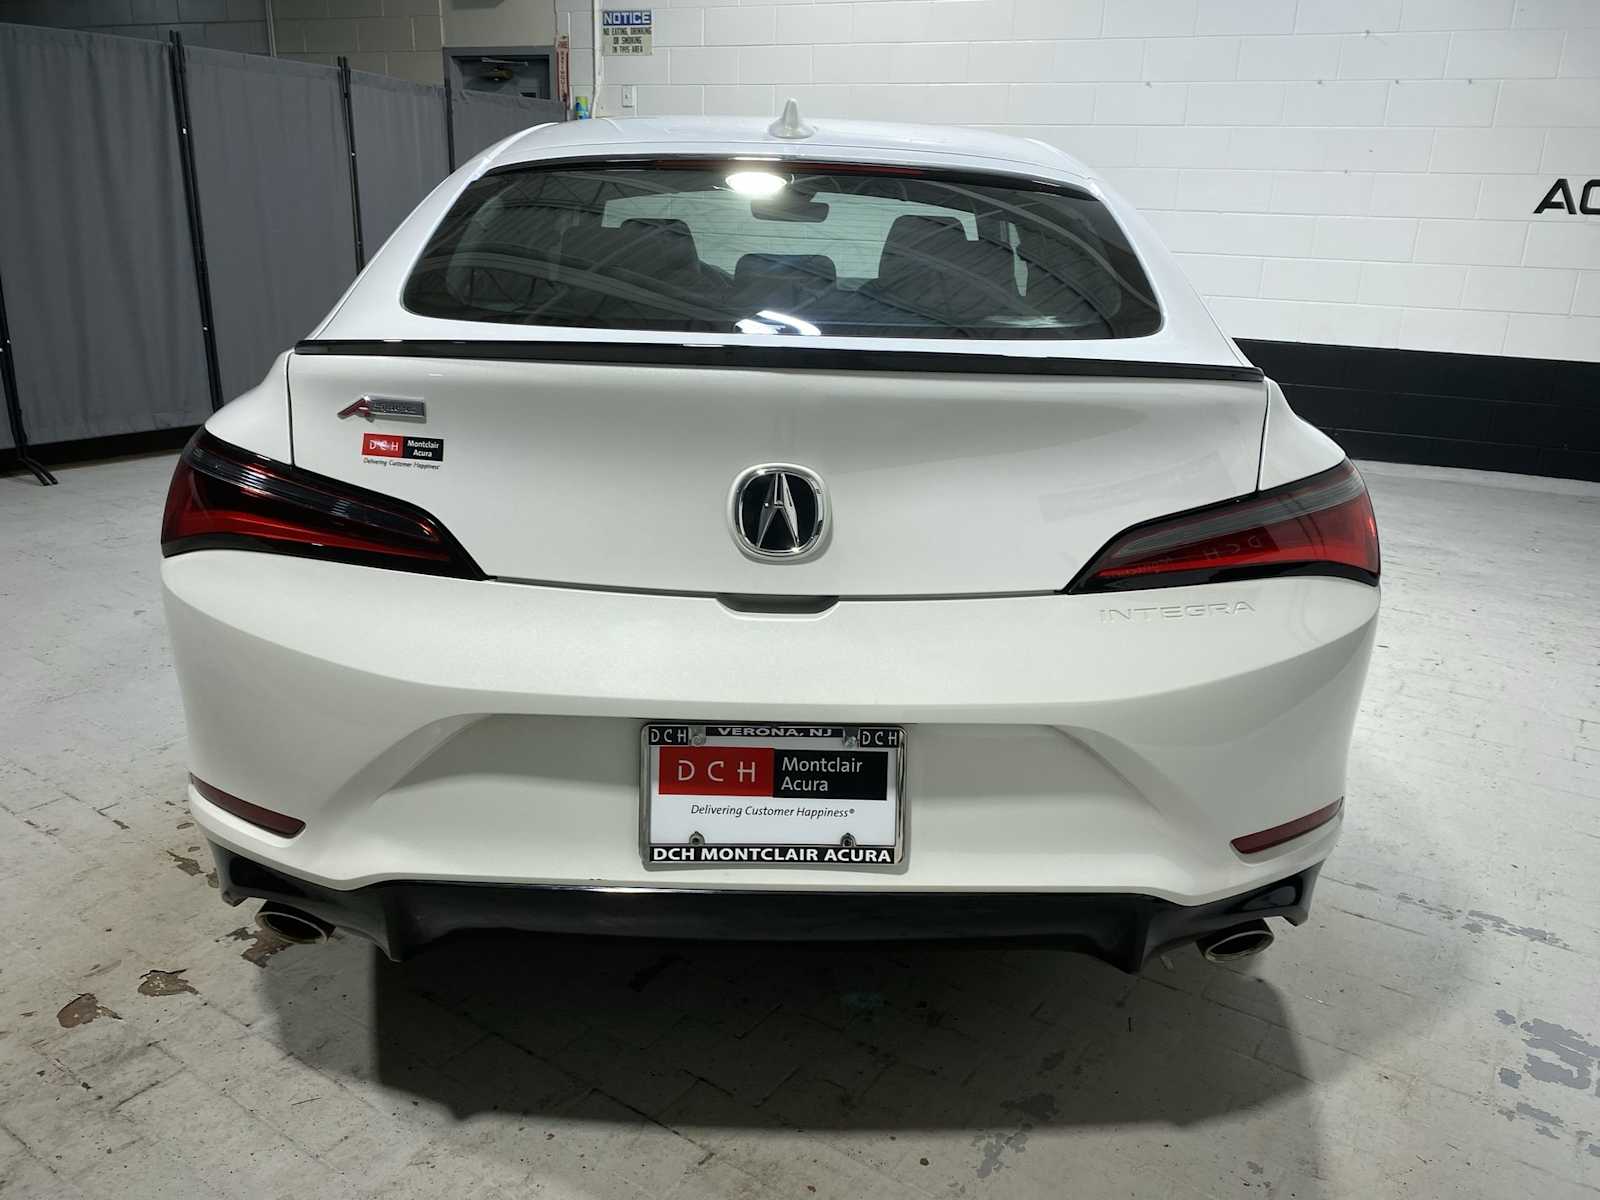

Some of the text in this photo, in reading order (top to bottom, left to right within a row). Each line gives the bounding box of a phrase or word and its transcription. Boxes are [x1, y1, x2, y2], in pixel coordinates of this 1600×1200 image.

[603, 12, 651, 24] NOTICE
[407, 440, 440, 449] Montclair
[413, 449, 433, 457] Acura
[1099, 600, 1256, 623] INTEGRA
[717, 727, 832, 738] VERONA, NJ
[781, 756, 863, 773] Montclair
[781, 775, 829, 792] Acura
[691, 804, 742, 818] Delivering
[745, 805, 795, 817] Customer
[653, 847, 891, 863] DCH MONTCLAIR ACURA
